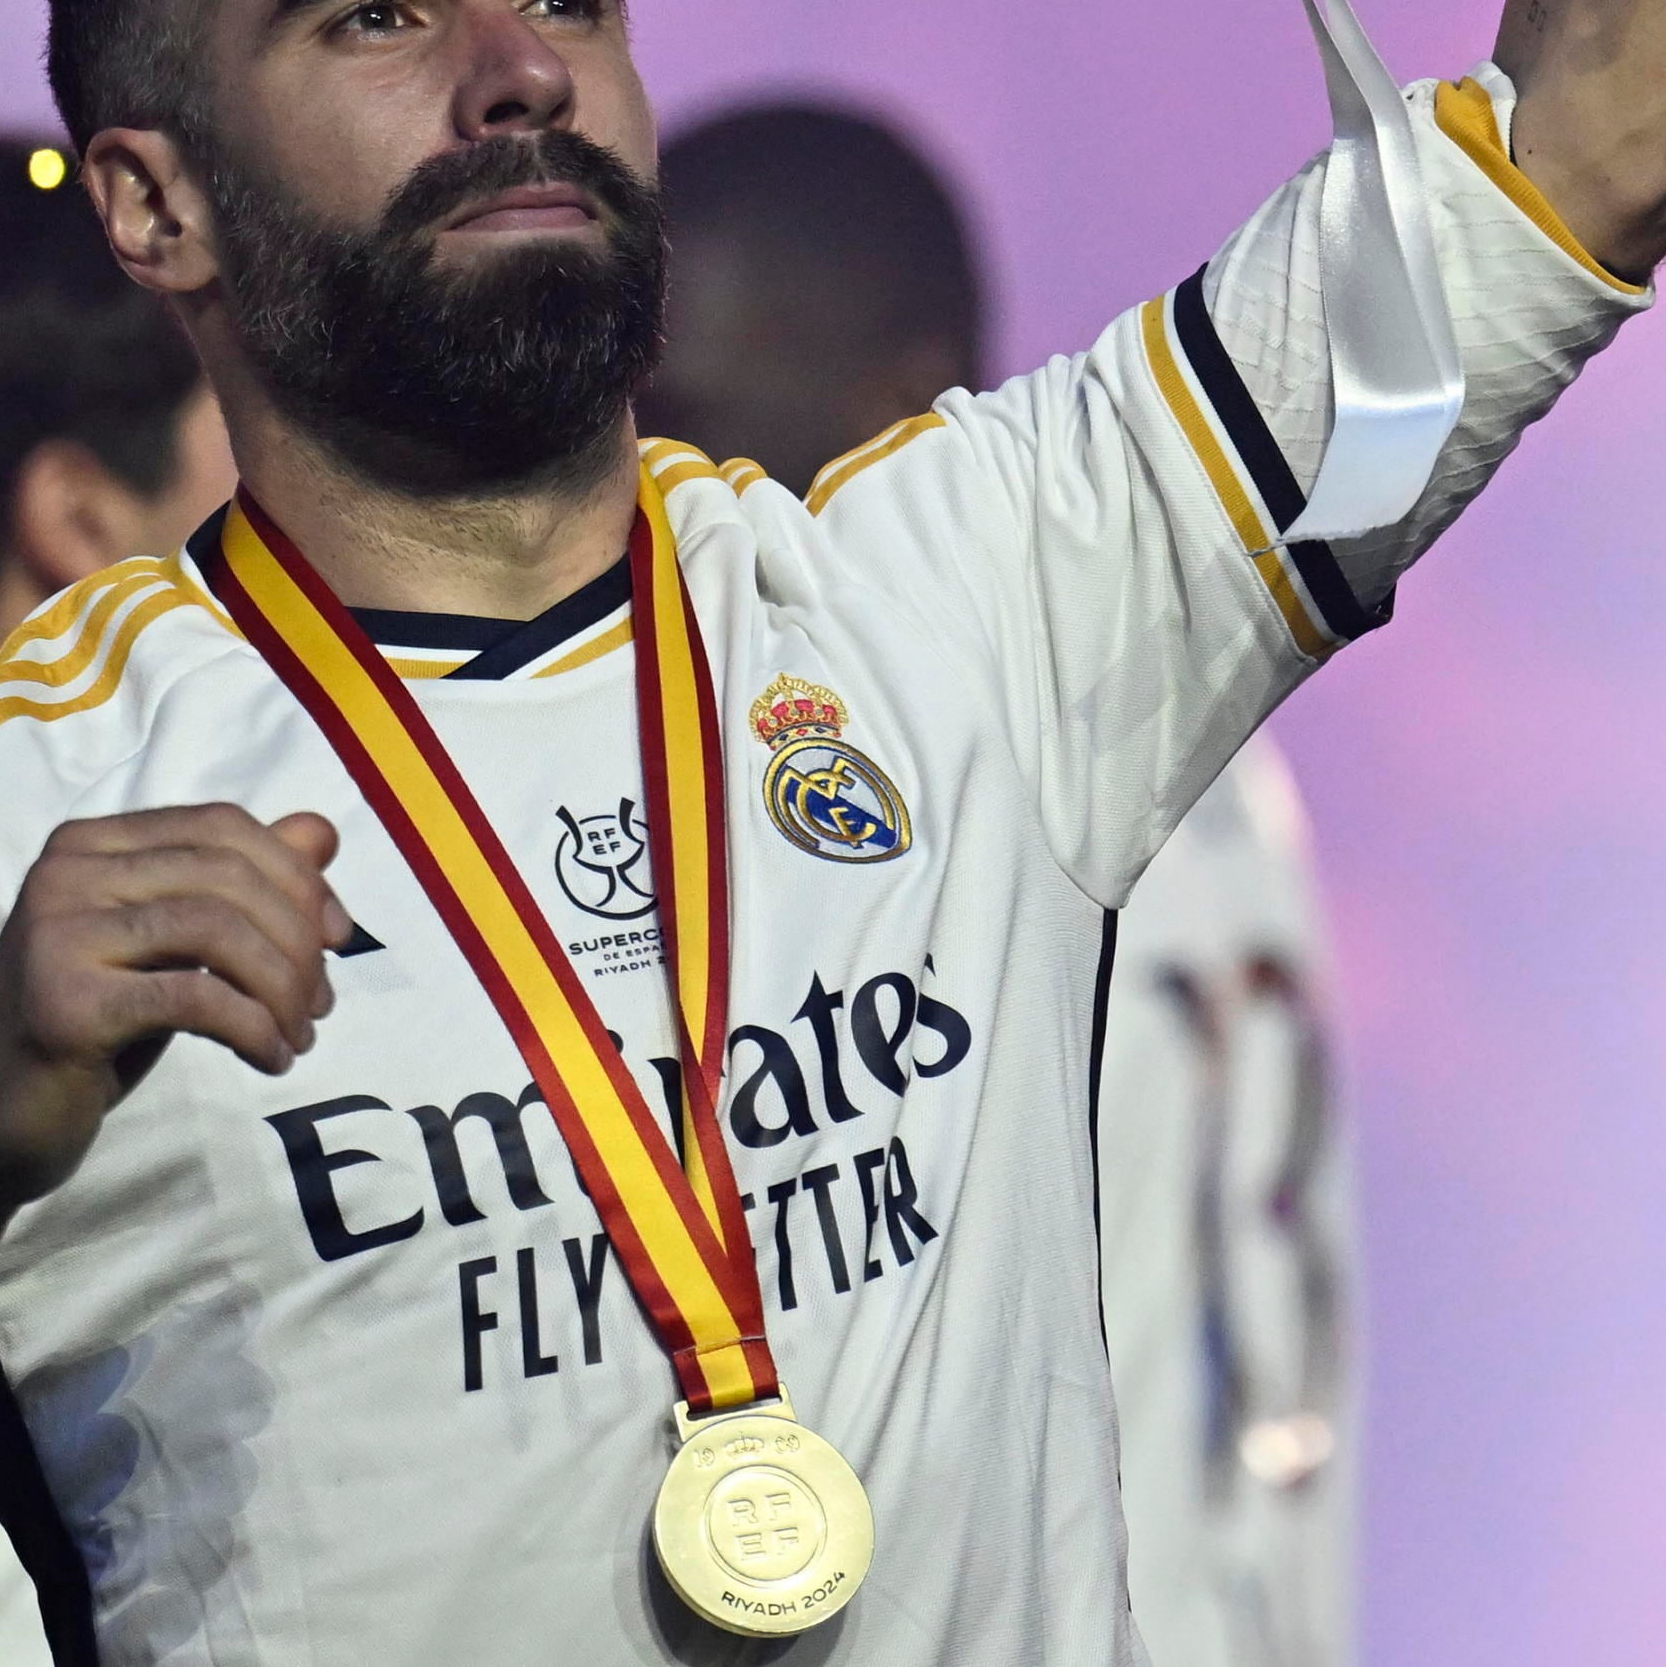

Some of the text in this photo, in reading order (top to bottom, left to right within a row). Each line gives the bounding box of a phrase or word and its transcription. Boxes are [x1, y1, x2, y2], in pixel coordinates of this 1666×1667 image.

[587, 827, 616, 843] RF
[592, 841, 621, 855] EF
[569, 927, 663, 955] SUPERC
[603, 942, 667, 962] DE ESPA
[594, 960, 651, 977] RIYADH
[458, 1233, 608, 1392] FLY
[728, 1492, 790, 1526] RF
[735, 1527, 799, 1561] EF
[721, 1571, 846, 1616] RIYADH 2024
